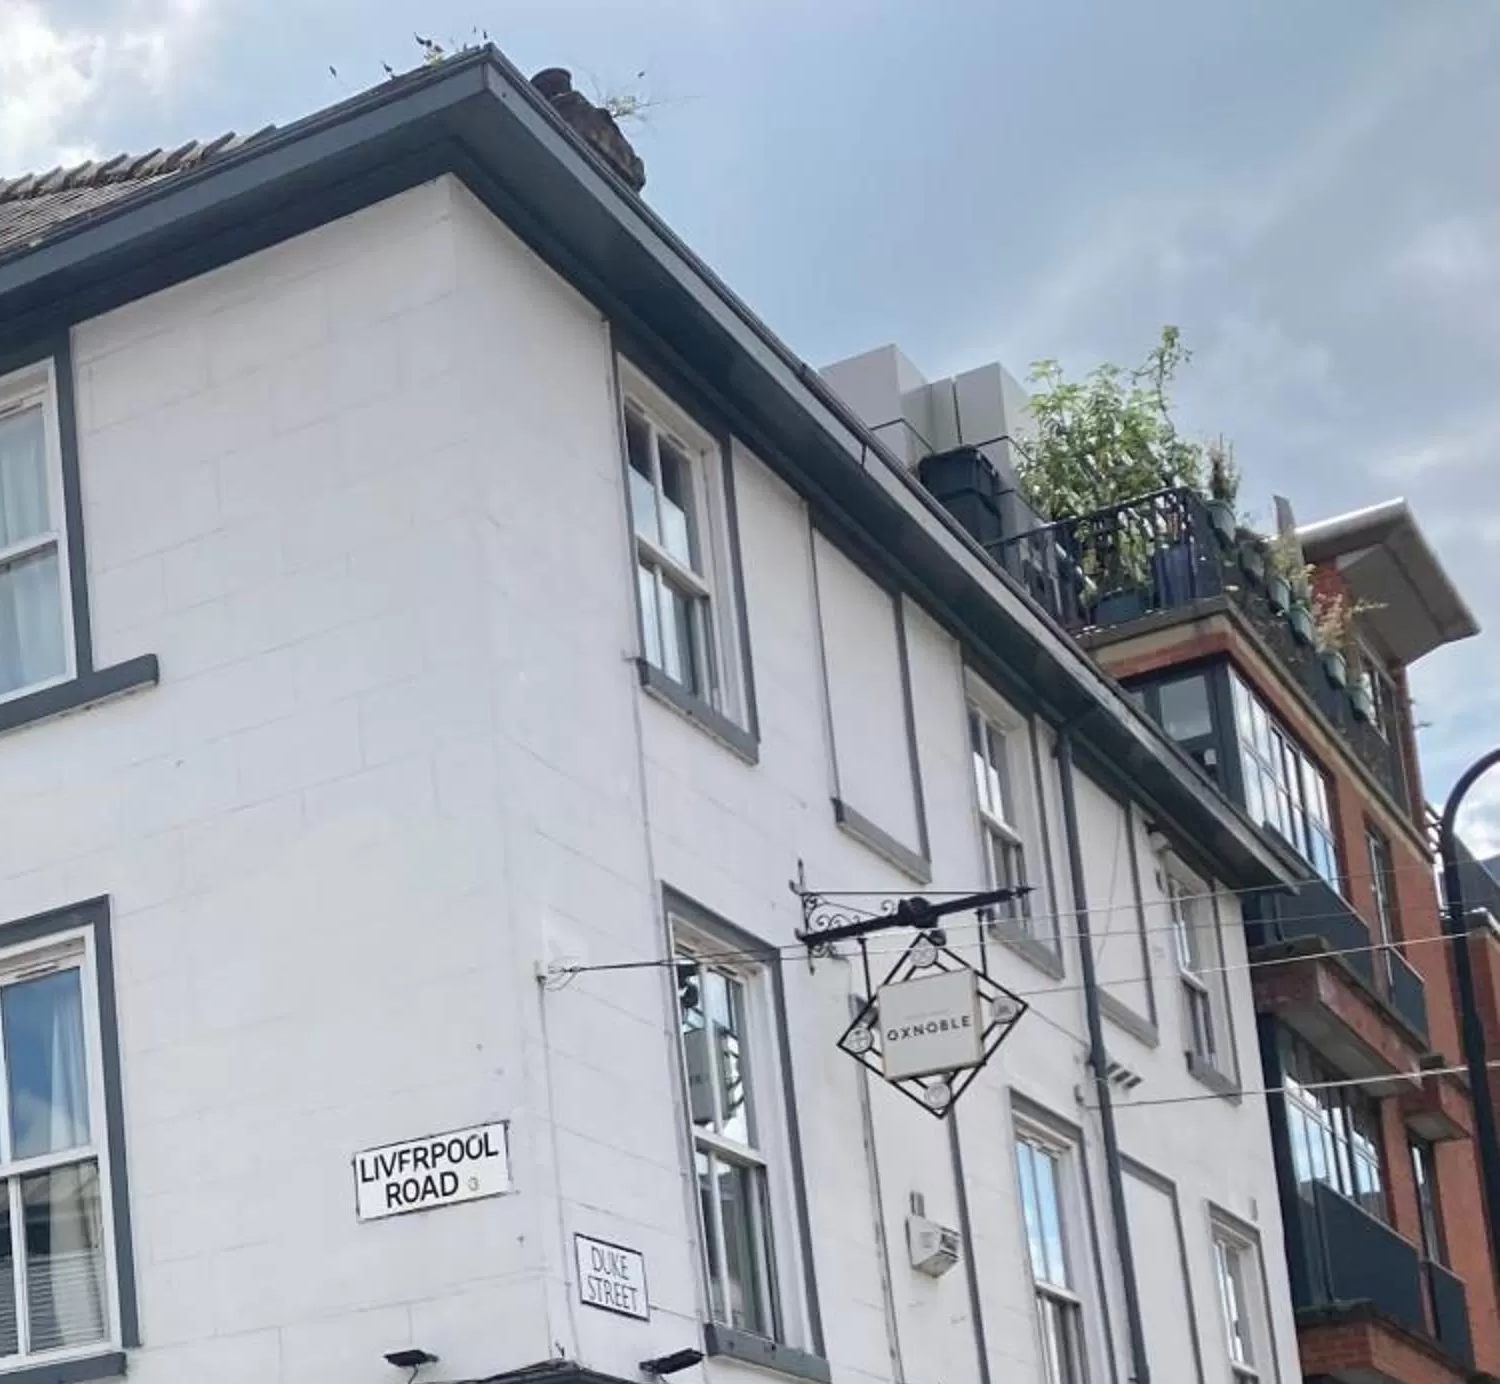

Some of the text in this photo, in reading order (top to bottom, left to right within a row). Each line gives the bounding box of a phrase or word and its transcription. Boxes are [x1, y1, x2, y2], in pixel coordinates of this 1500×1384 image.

[887, 1015, 972, 1041] OXNOBLE
[385, 1171, 459, 1208] ROAD
[591, 1247, 629, 1280] DUKE
[587, 1276, 638, 1312] STREET
